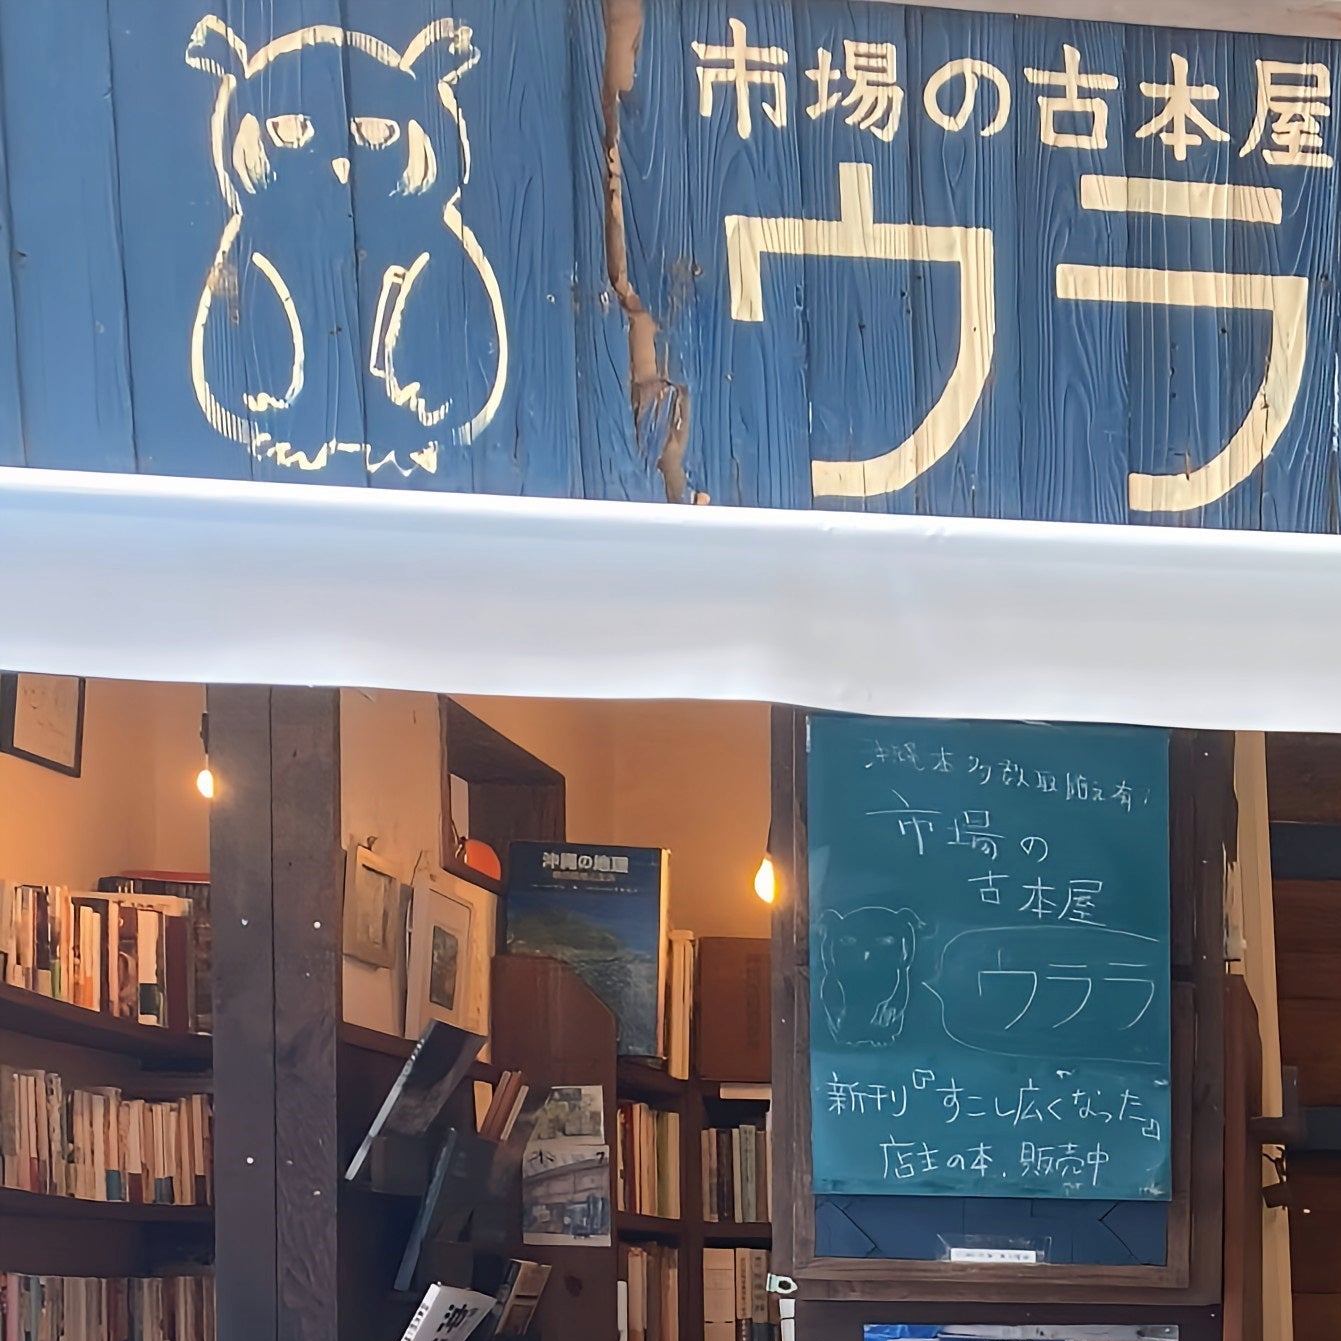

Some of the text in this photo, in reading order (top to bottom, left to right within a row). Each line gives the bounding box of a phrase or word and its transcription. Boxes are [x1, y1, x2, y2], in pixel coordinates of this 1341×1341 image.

[692, 18, 1334, 169] 市場の古本屋
[865, 789, 1049, 863] 市場の
[967, 870, 1107, 927] 古本屋
[978, 949, 1156, 1030] ウララ
